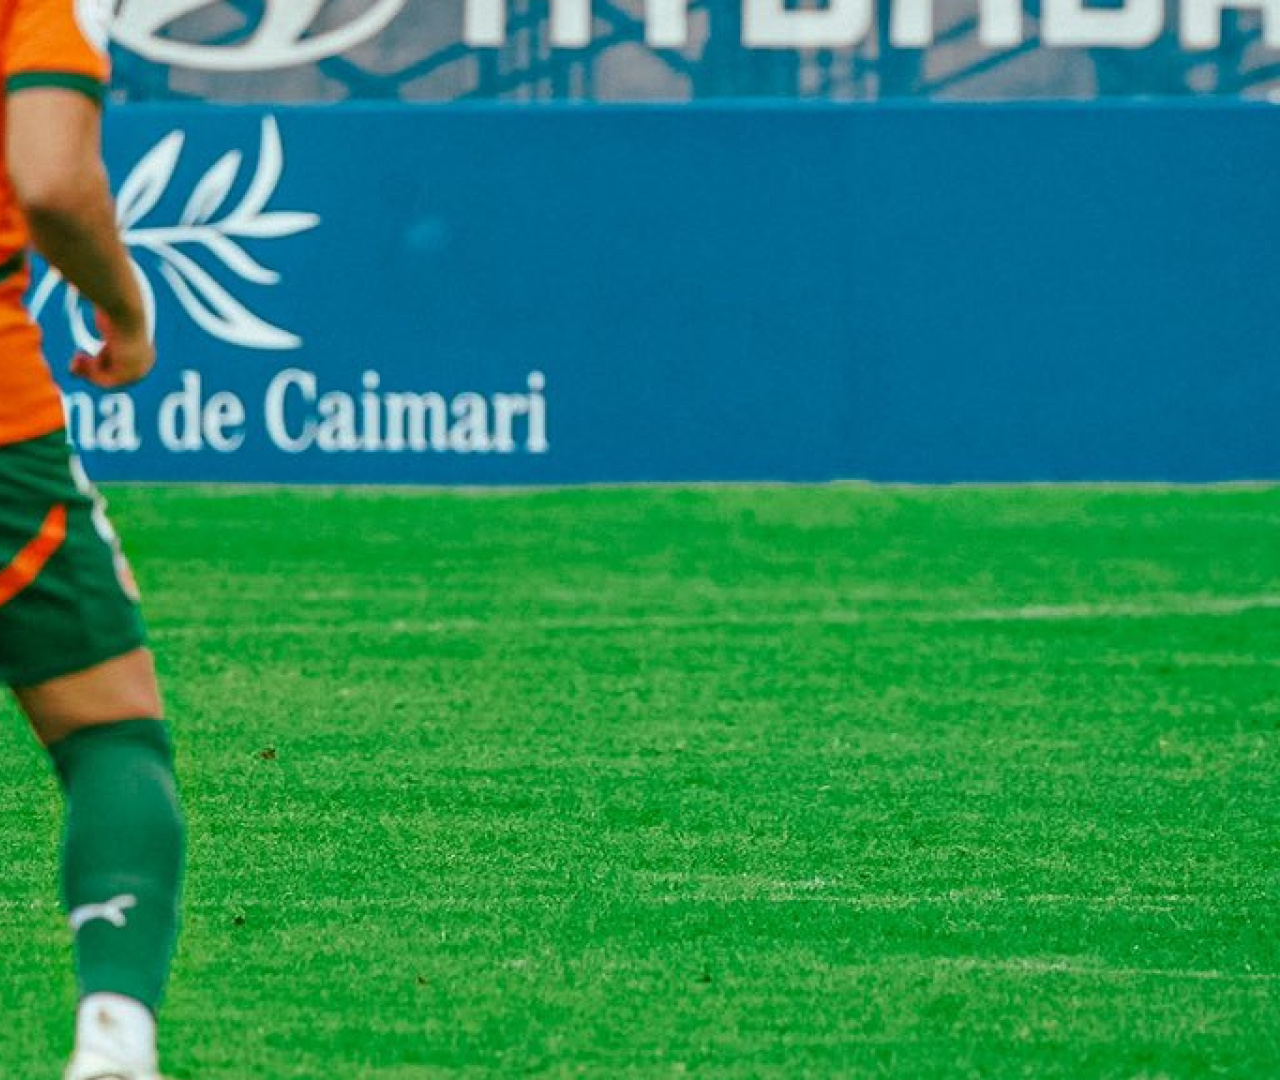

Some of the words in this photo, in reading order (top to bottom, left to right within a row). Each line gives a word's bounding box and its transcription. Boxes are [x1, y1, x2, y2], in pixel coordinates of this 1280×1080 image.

[63, 389, 142, 452] na
[157, 369, 245, 452] de
[264, 367, 549, 453] Caimari
